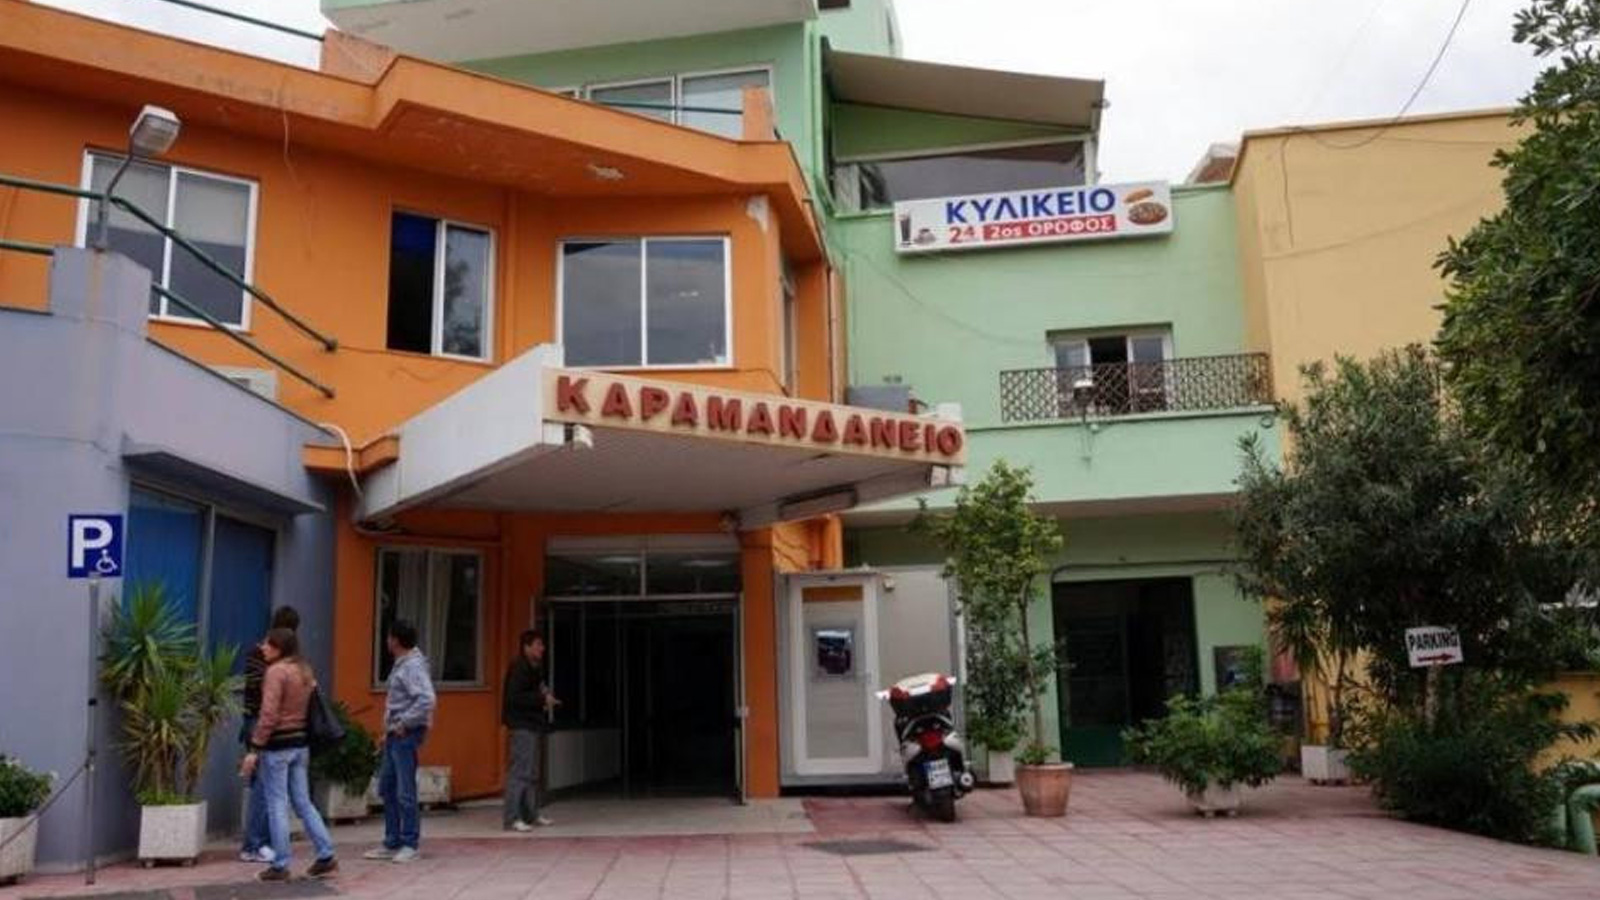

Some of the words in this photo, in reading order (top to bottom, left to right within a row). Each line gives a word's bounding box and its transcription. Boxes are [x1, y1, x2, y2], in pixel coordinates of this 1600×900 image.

[945, 188, 1116, 225] ΚΥΛΙΚΕΙΟ
[949, 226, 976, 244] 24
[1028, 217, 1114, 236] ΟΡΟΦΟΣ
[555, 375, 964, 456] ΚΑΡΑΜΑΝΔΑΝΕΙΟ
[72, 519, 113, 568] P
[1408, 630, 1459, 652] PARKING
